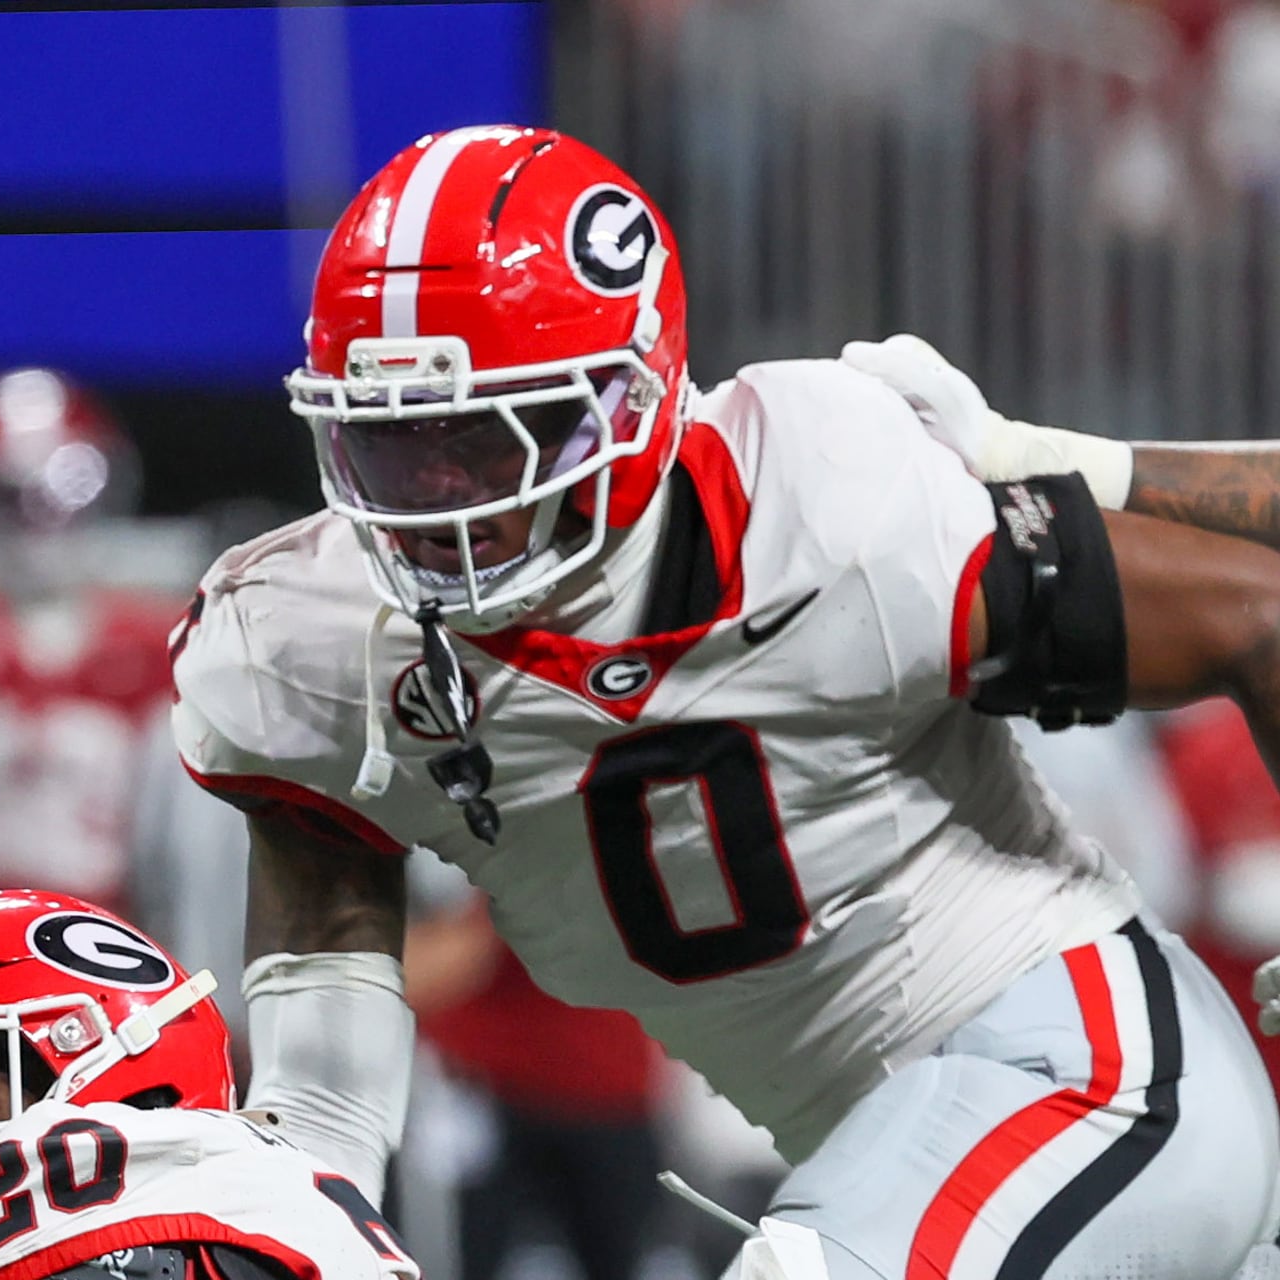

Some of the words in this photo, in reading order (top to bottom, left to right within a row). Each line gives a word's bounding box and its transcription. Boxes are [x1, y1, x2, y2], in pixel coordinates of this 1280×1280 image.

[572, 189, 656, 290] G
[590, 658, 650, 697] G
[577, 720, 810, 986] 0
[32, 914, 171, 986] G
